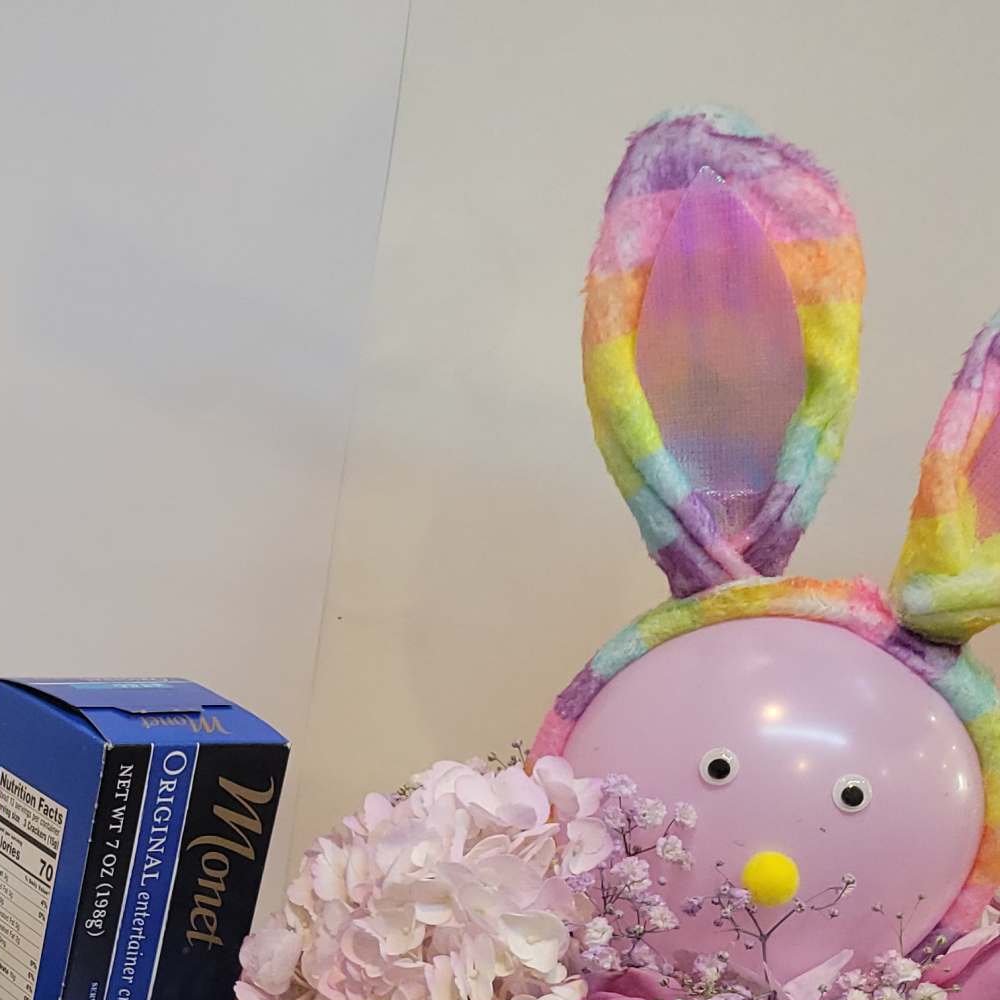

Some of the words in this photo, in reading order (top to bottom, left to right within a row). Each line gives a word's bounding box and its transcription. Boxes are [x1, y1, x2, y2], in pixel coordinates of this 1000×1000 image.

[115, 764, 134, 802] NET
[37, 796, 64, 825] Facts
[109, 806, 126, 833] WT
[141, 750, 187, 887] ORIGINAL
[106, 840, 119, 848] 7
[37, 857, 54, 883] 70
[100, 854, 117, 878] OZ
[185, 775, 275, 952] Monet
[85, 883, 114, 937] (198g)
[119, 891, 150, 984] entertainer
